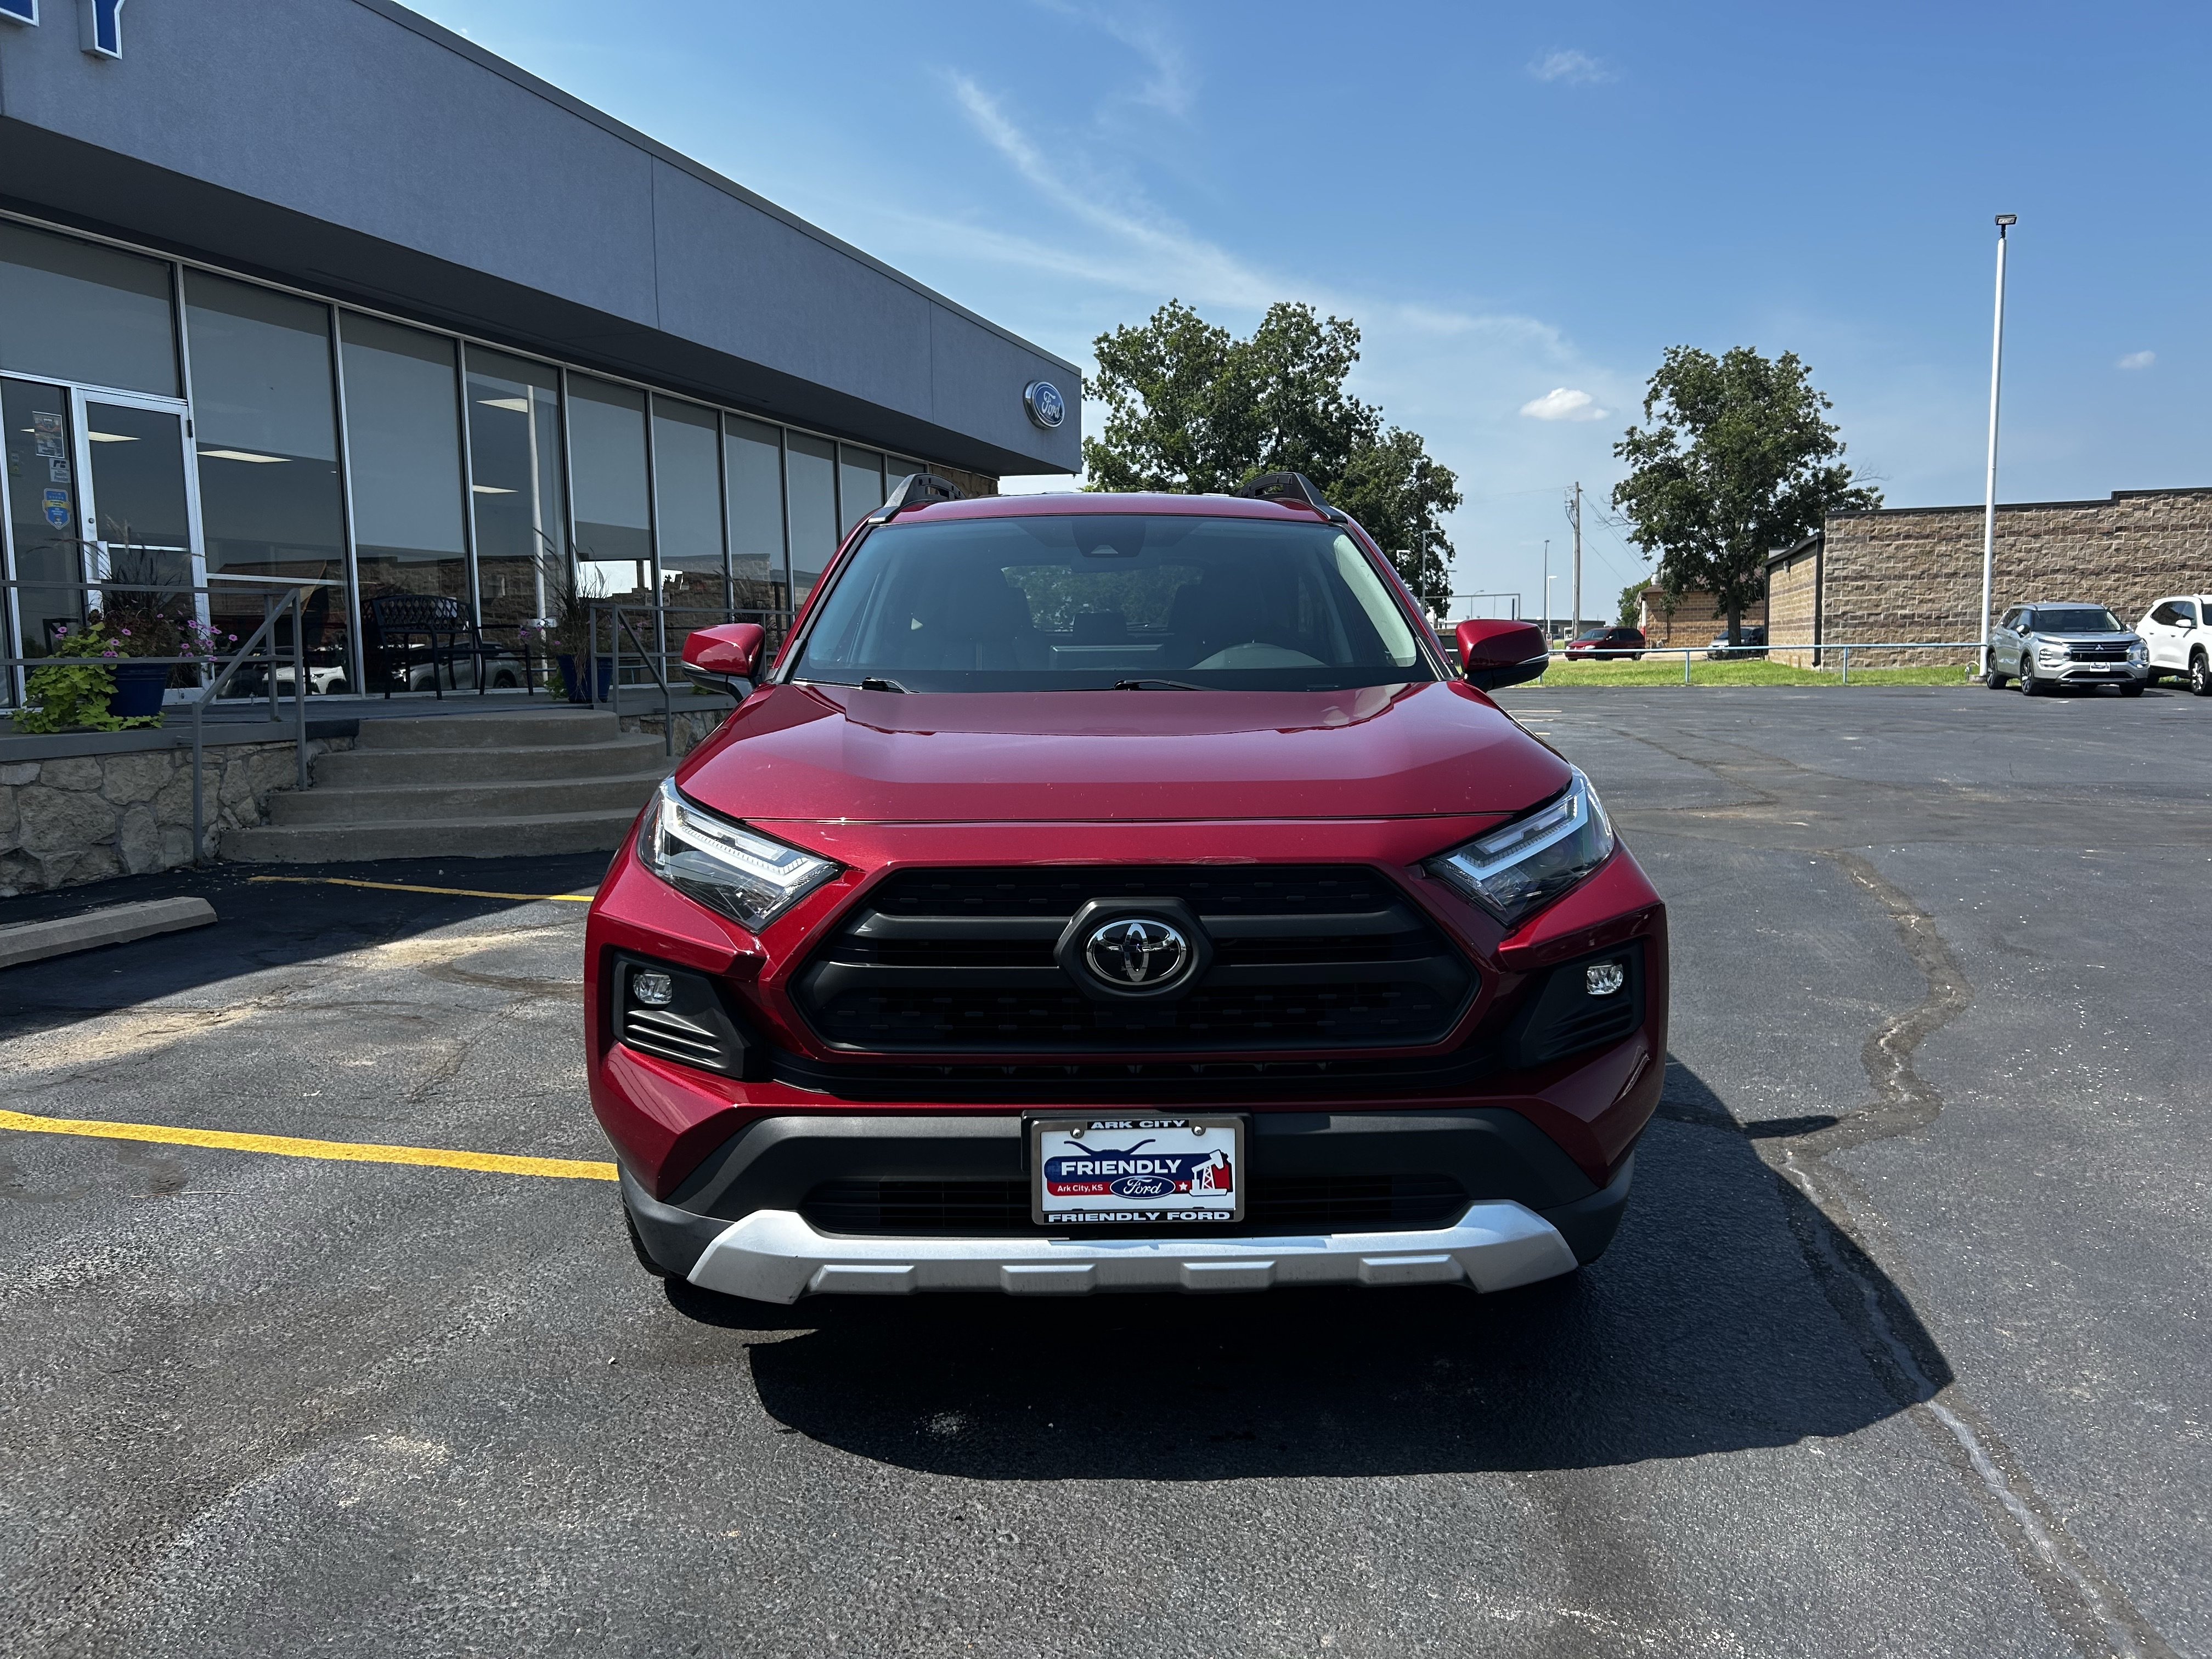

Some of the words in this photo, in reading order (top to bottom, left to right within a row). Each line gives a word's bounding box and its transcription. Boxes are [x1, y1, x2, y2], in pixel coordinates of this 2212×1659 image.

[1042, 391, 1060, 419] Ford
[1091, 1121, 1133, 1129] ARK
[1139, 1120, 1186, 1128] CITY
[1061, 1159, 1182, 1176] FRIENDLY
[1123, 1178, 1161, 1194] Ford
[1048, 1212, 1160, 1222] FRIENDLY
[1167, 1211, 1230, 1220] FORD
